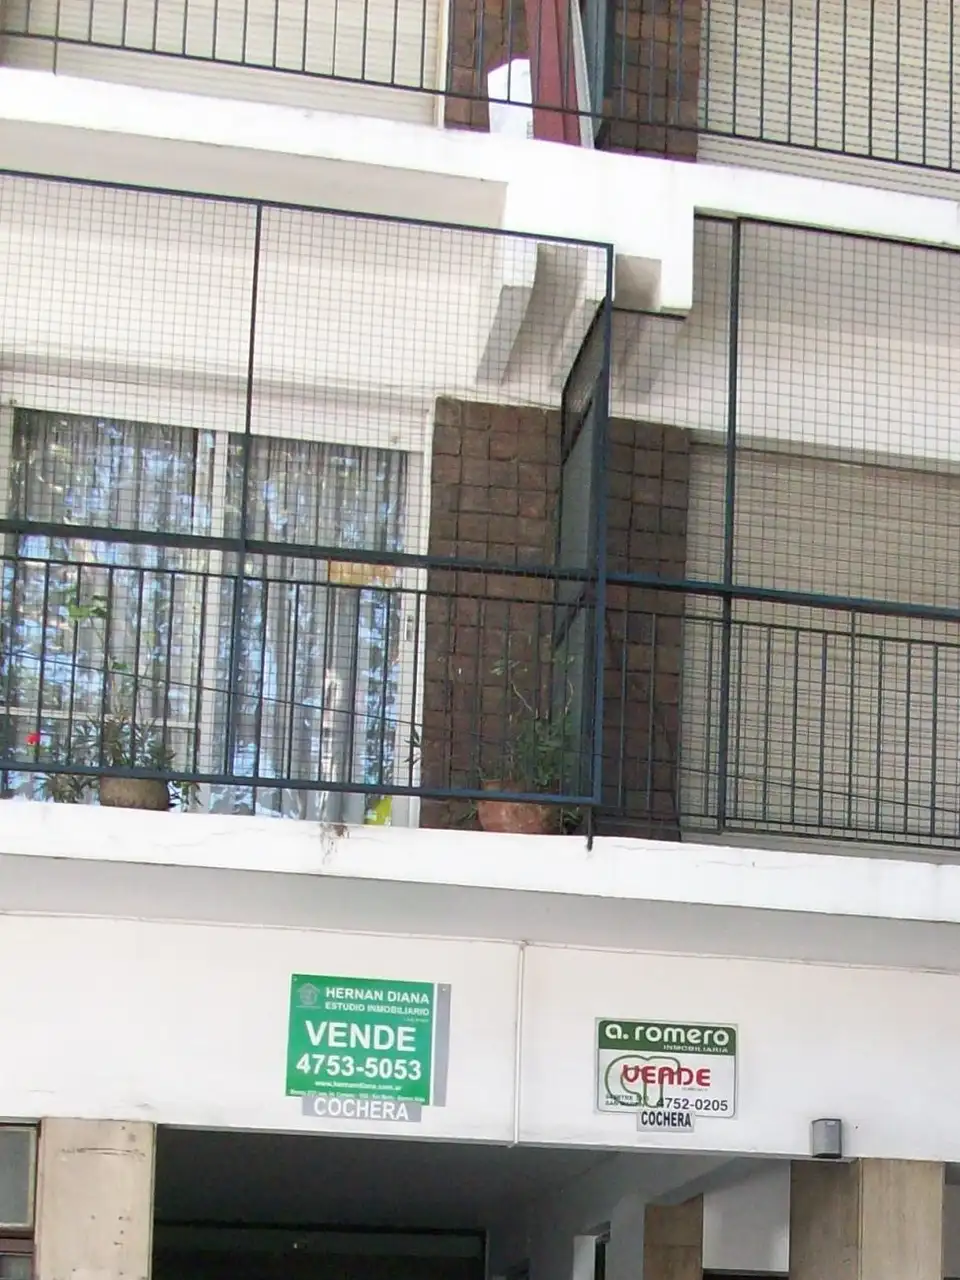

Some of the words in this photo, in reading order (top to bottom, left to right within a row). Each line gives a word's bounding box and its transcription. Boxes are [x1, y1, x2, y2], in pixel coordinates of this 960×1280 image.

[326, 987, 383, 1001] HERNAN
[387, 991, 430, 1004] DIANA
[325, 1002, 366, 1012] ESTUDIO
[367, 1005, 430, 1016] INMOBILIARIO
[305, 1020, 417, 1052] VENDE
[635, 1025, 729, 1046] romero
[296, 1053, 422, 1080] 4753-5053
[314, 1098, 409, 1120] COCHERA
[657, 1096, 729, 1112] 4752-0205
[641, 1111, 692, 1127] COCHERA
